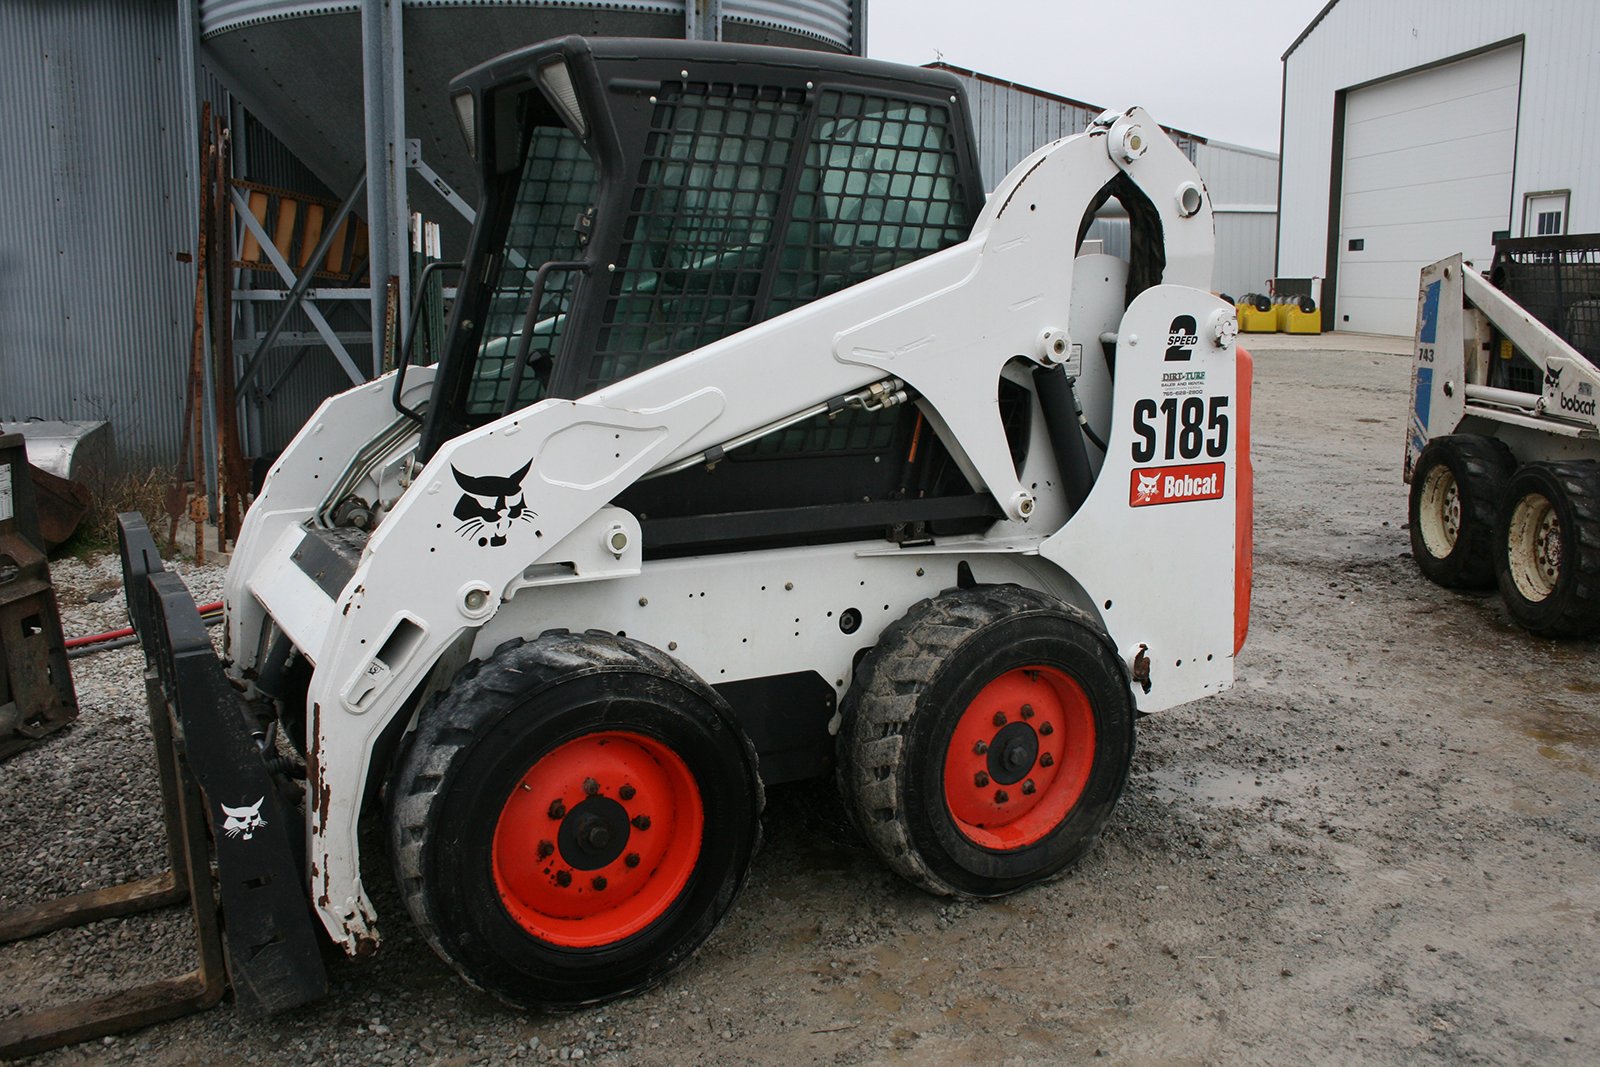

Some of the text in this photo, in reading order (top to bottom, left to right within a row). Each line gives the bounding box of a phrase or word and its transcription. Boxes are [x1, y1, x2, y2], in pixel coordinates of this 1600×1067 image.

[1164, 314, 1197, 362] 2
[1167, 335, 1198, 346] SPEED
[1418, 348, 1435, 363] 743
[1560, 391, 1596, 416] bobcat
[1131, 396, 1229, 463] S185
[1163, 473, 1217, 498] Bobcat
